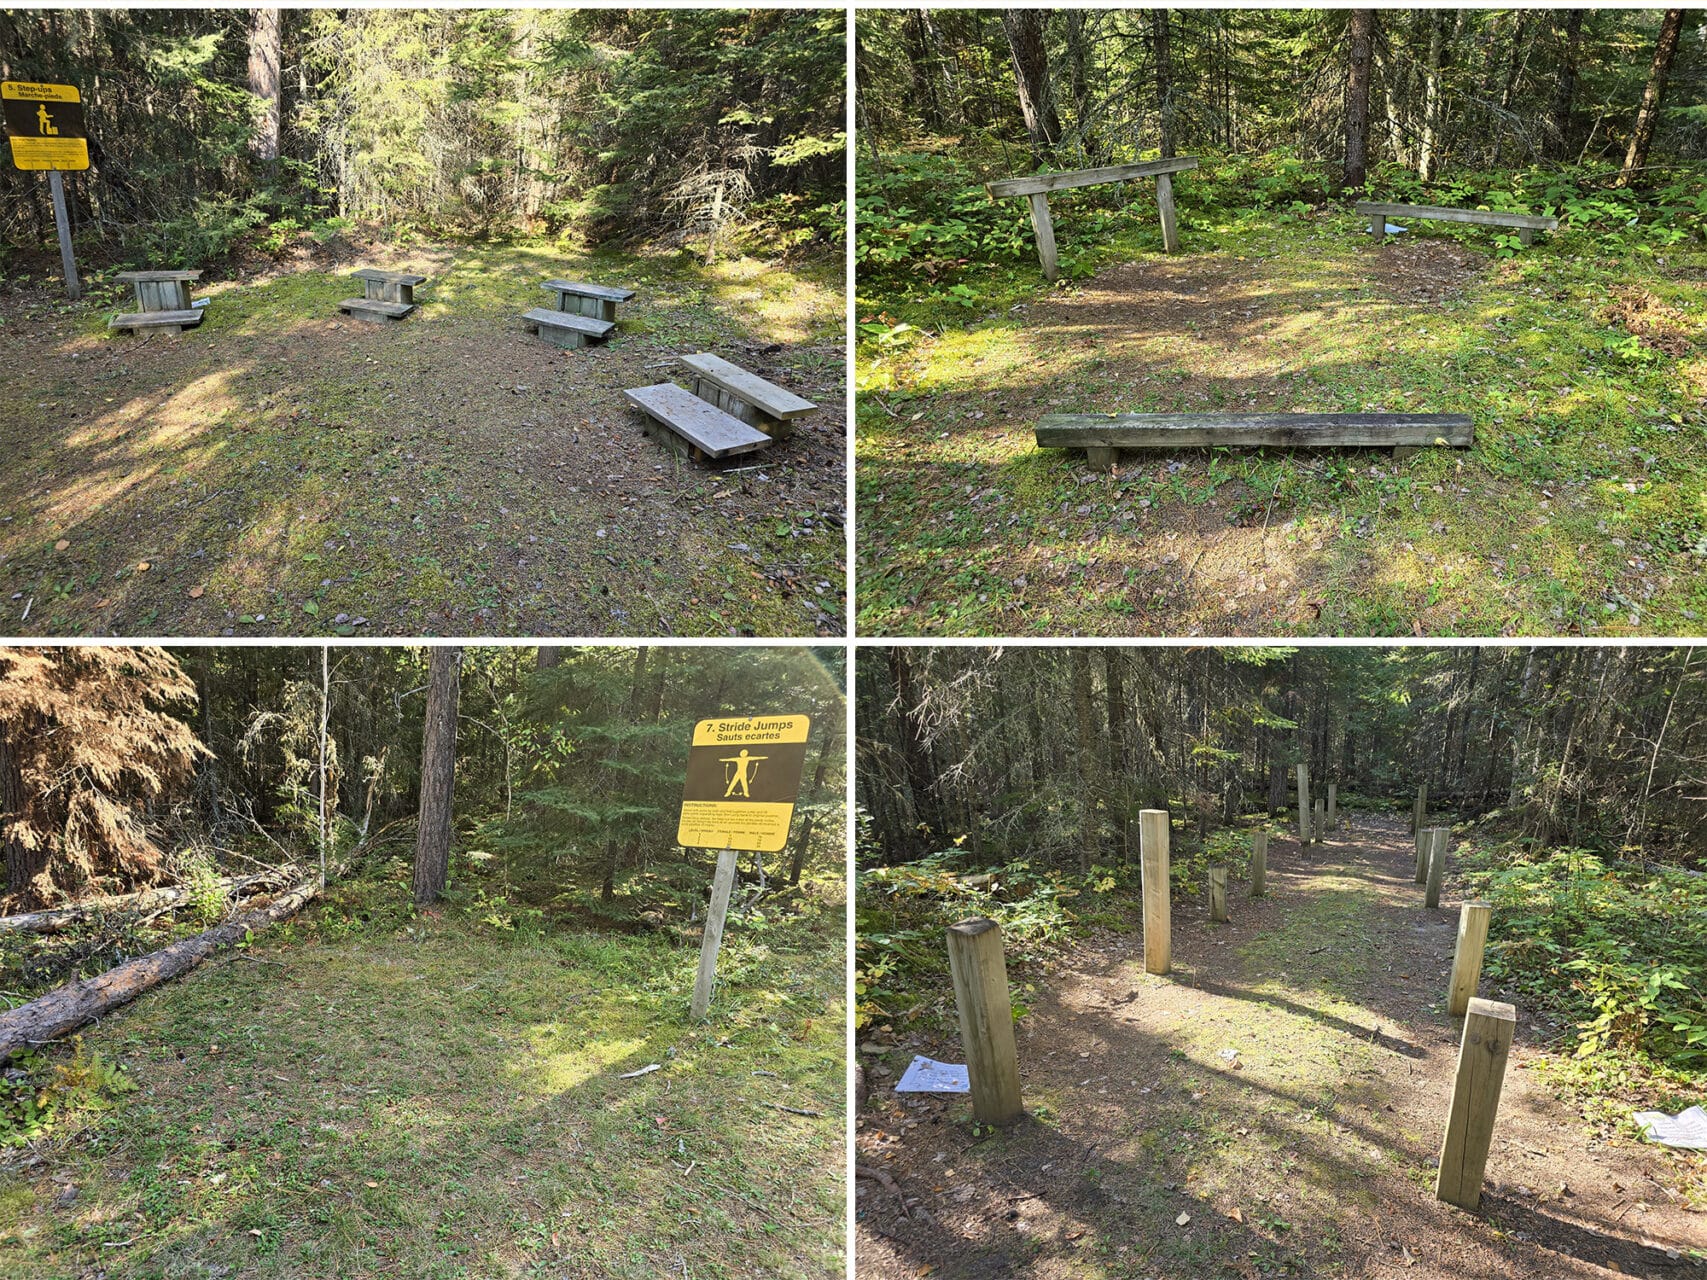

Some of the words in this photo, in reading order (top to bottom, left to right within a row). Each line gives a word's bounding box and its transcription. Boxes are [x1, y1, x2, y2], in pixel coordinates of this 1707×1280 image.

[706, 724, 715, 732] 7.
[718, 722, 751, 732] Stride
[754, 721, 793, 731] Jumps
[717, 733, 742, 741] Sauts
[745, 732, 780, 740] ecartes
